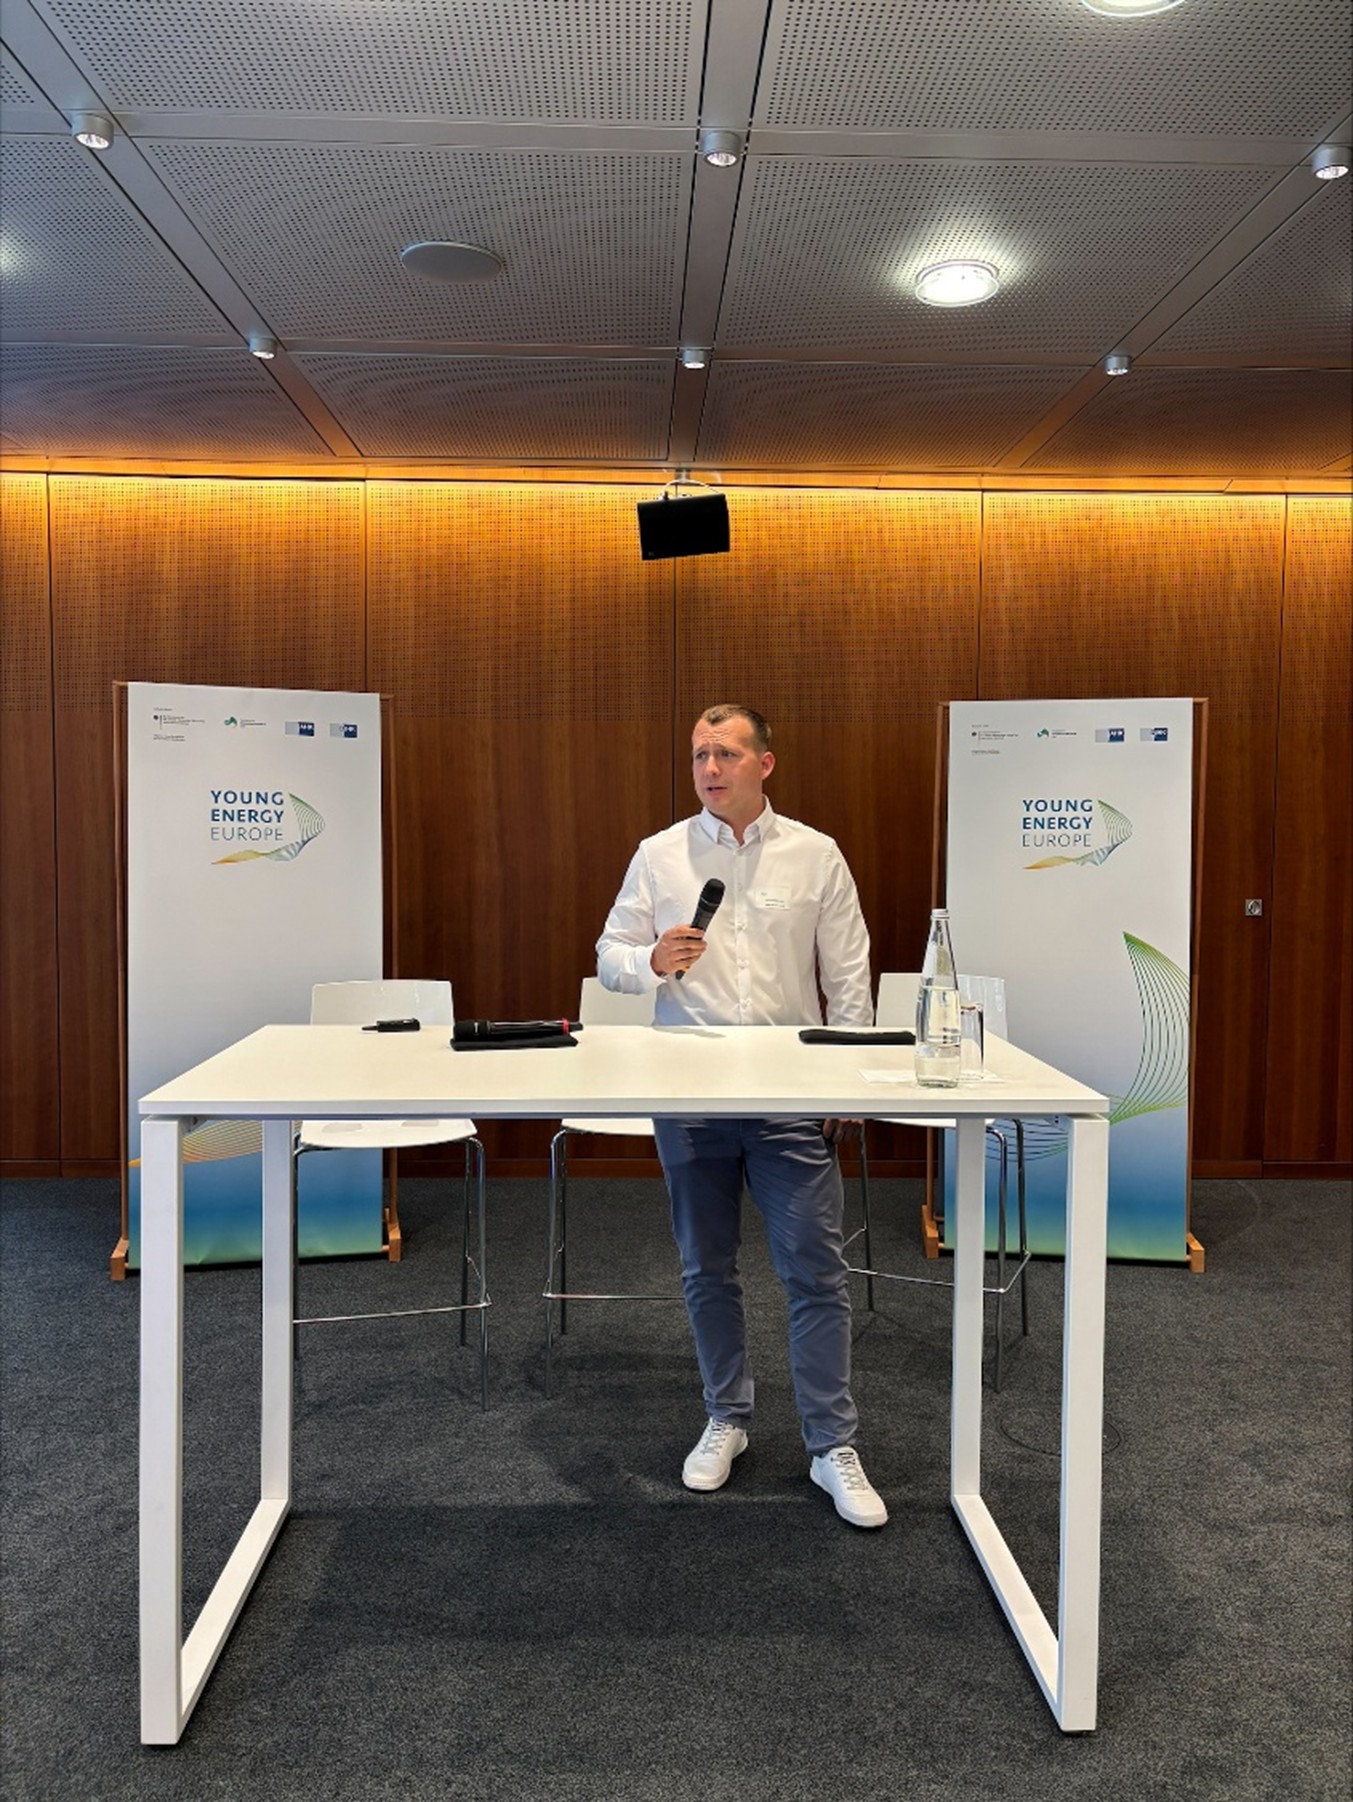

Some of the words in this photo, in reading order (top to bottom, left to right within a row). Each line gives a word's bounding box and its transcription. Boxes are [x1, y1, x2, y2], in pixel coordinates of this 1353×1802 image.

[211, 790, 284, 805] YOUNG
[1023, 799, 1093, 812] YOUNG
[211, 809, 284, 823] ENERGY
[1023, 817, 1093, 830] ENERGY
[210, 827, 283, 841] EUROPE
[1022, 833, 1092, 847] EUROPE
